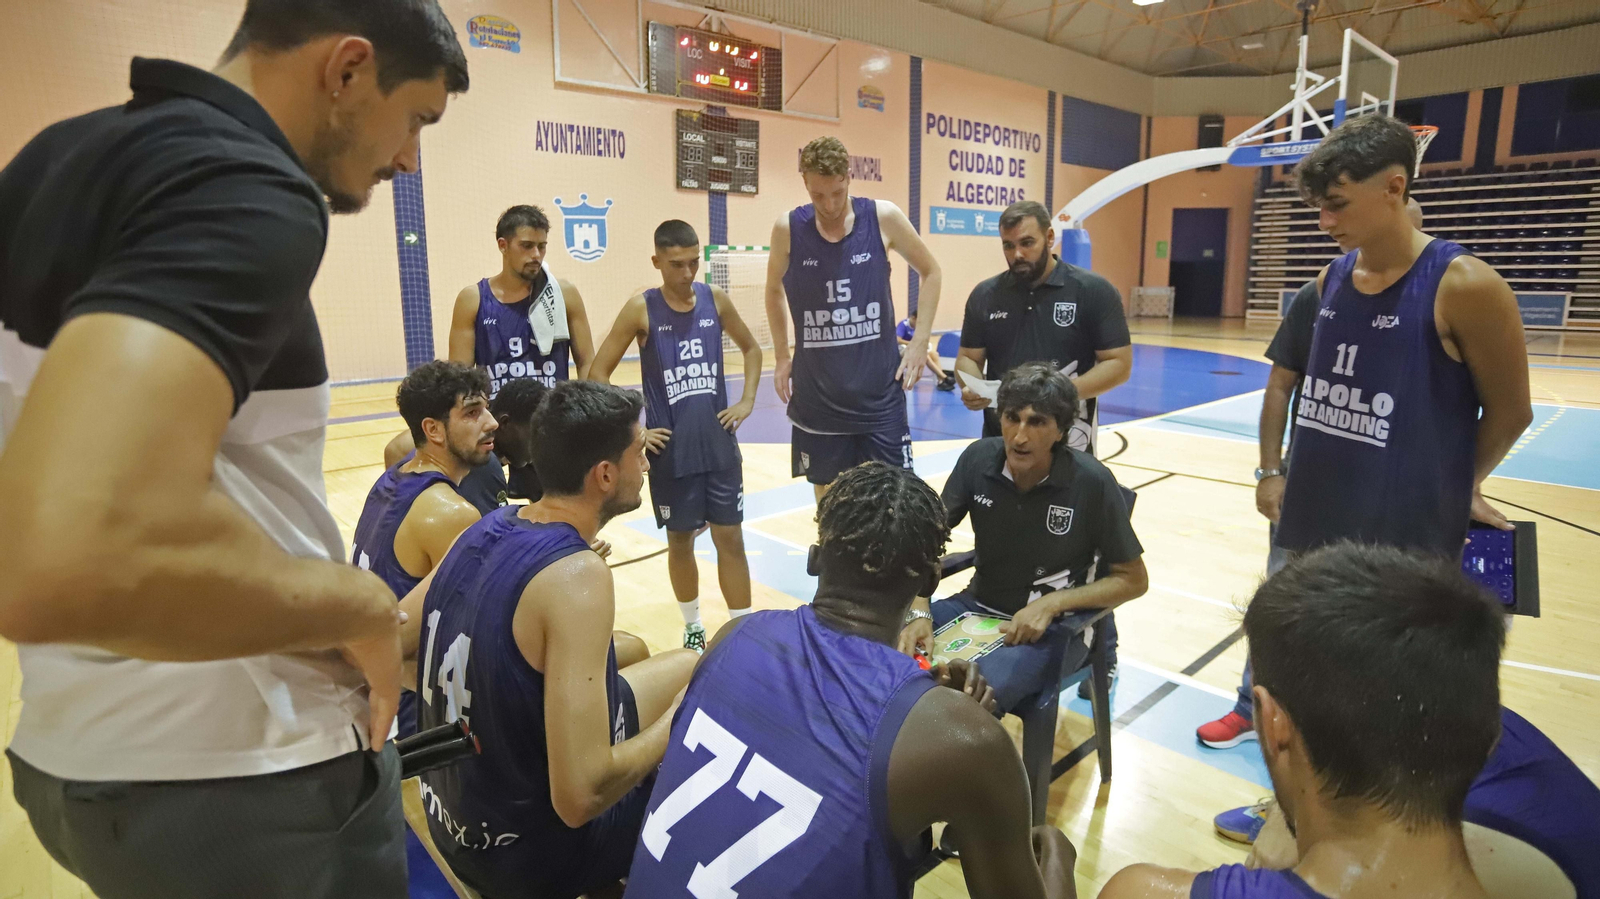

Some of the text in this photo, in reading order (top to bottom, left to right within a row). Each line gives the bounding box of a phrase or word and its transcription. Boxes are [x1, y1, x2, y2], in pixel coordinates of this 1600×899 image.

[687, 47, 703, 60] LOC
[535, 120, 626, 160] AYUNTAMIENTO
[682, 132, 706, 143] LOCAL
[926, 112, 1042, 154] POLIDEPORTIVO
[948, 149, 1026, 179] CIUDAD DE
[946, 180, 1026, 207] ALGECIRAS
[825, 278, 852, 304] 15
[803, 301, 881, 327] APOLO
[803, 318, 881, 341] BRANDING
[508, 336, 524, 358] 9
[678, 337, 704, 361] 26
[1331, 342, 1359, 377] 11
[1301, 374, 1395, 418] APOLO
[1296, 397, 1391, 441] BRANDING
[421, 608, 472, 727] 14
[641, 706, 824, 899] 77
